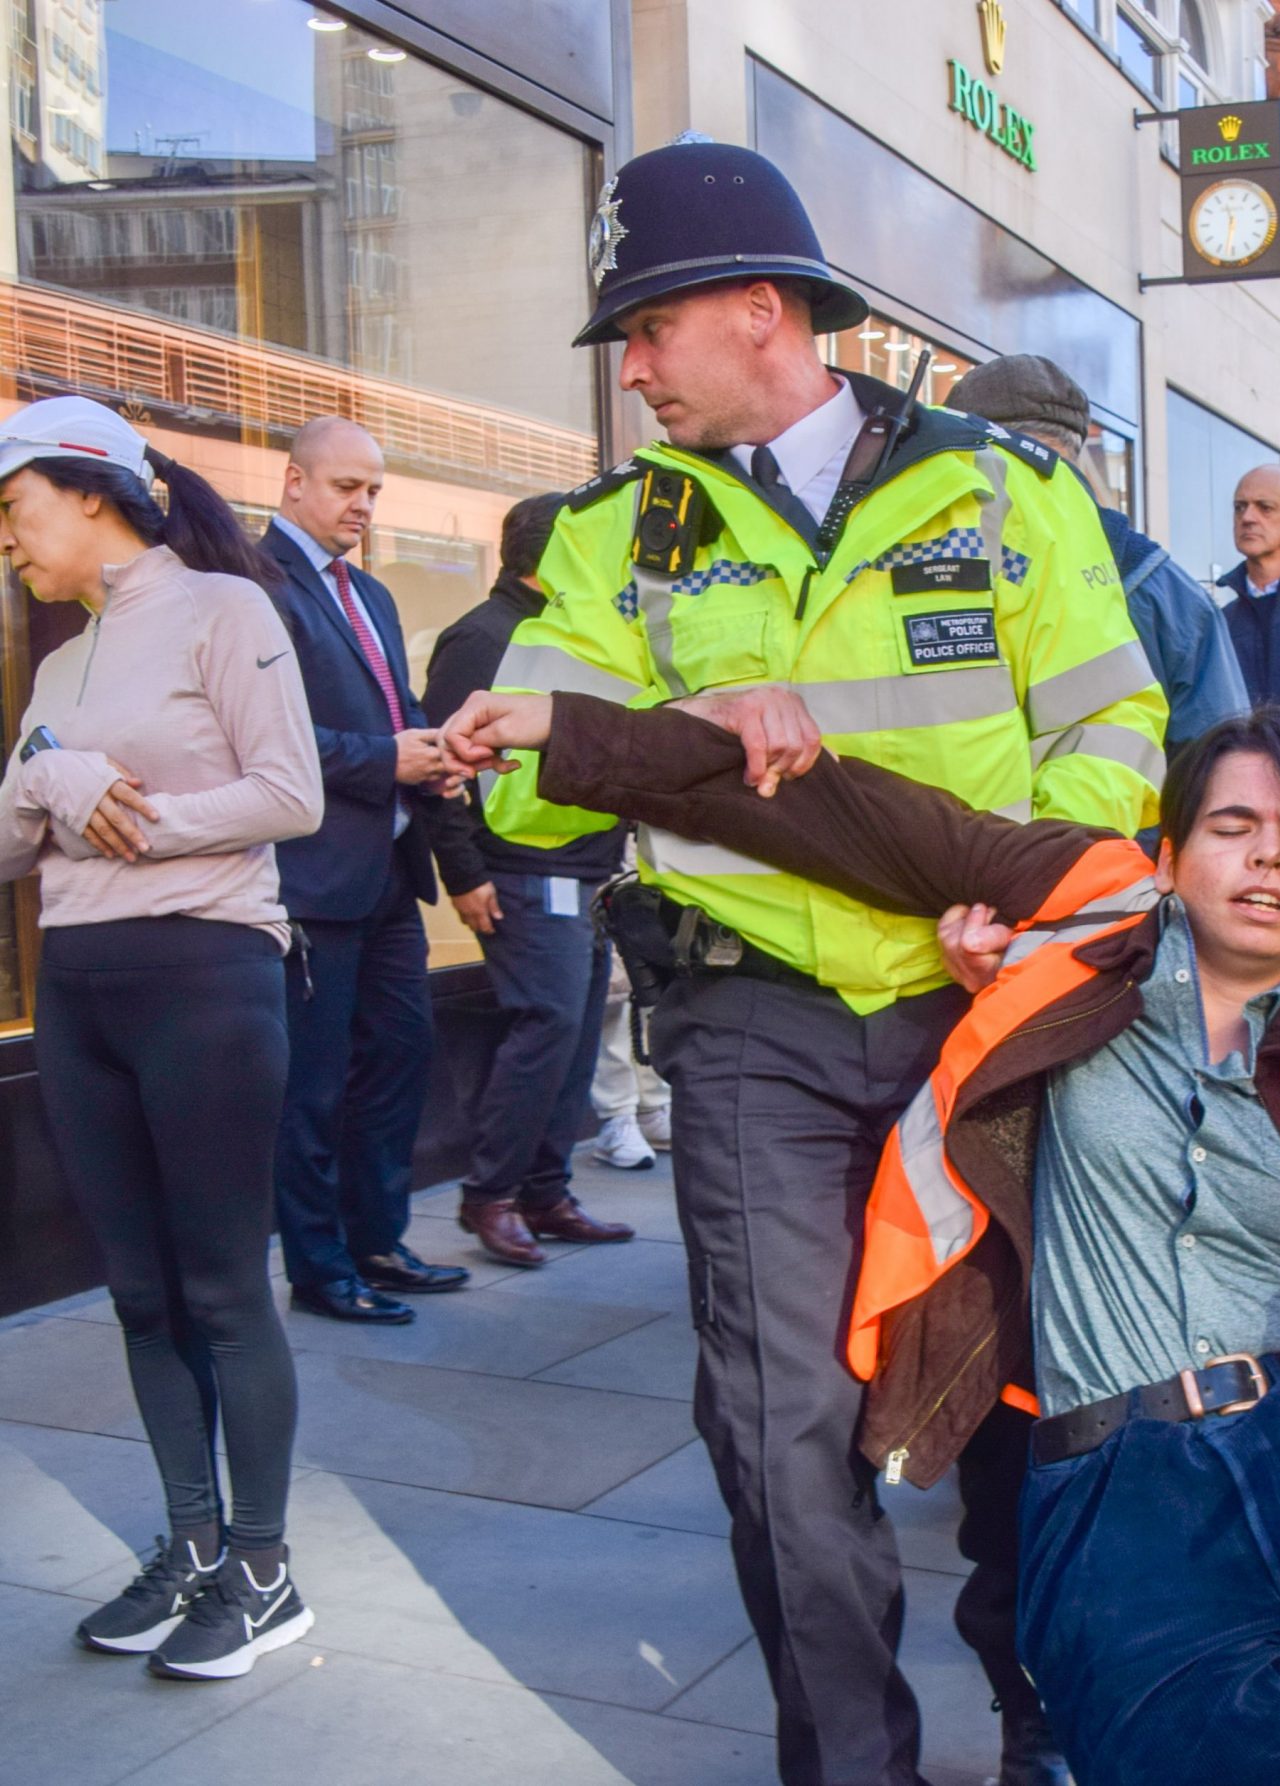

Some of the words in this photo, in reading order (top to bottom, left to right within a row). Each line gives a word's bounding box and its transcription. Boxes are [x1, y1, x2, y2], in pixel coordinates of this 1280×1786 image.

[947, 58, 1037, 171] ROLEX
[1191, 143, 1270, 165] ROLEX
[940, 617, 988, 627] METROPOLITAN
[949, 625, 984, 637] POLICE
[915, 645, 954, 659] POLICE
[956, 642, 995, 655] OFFICER
